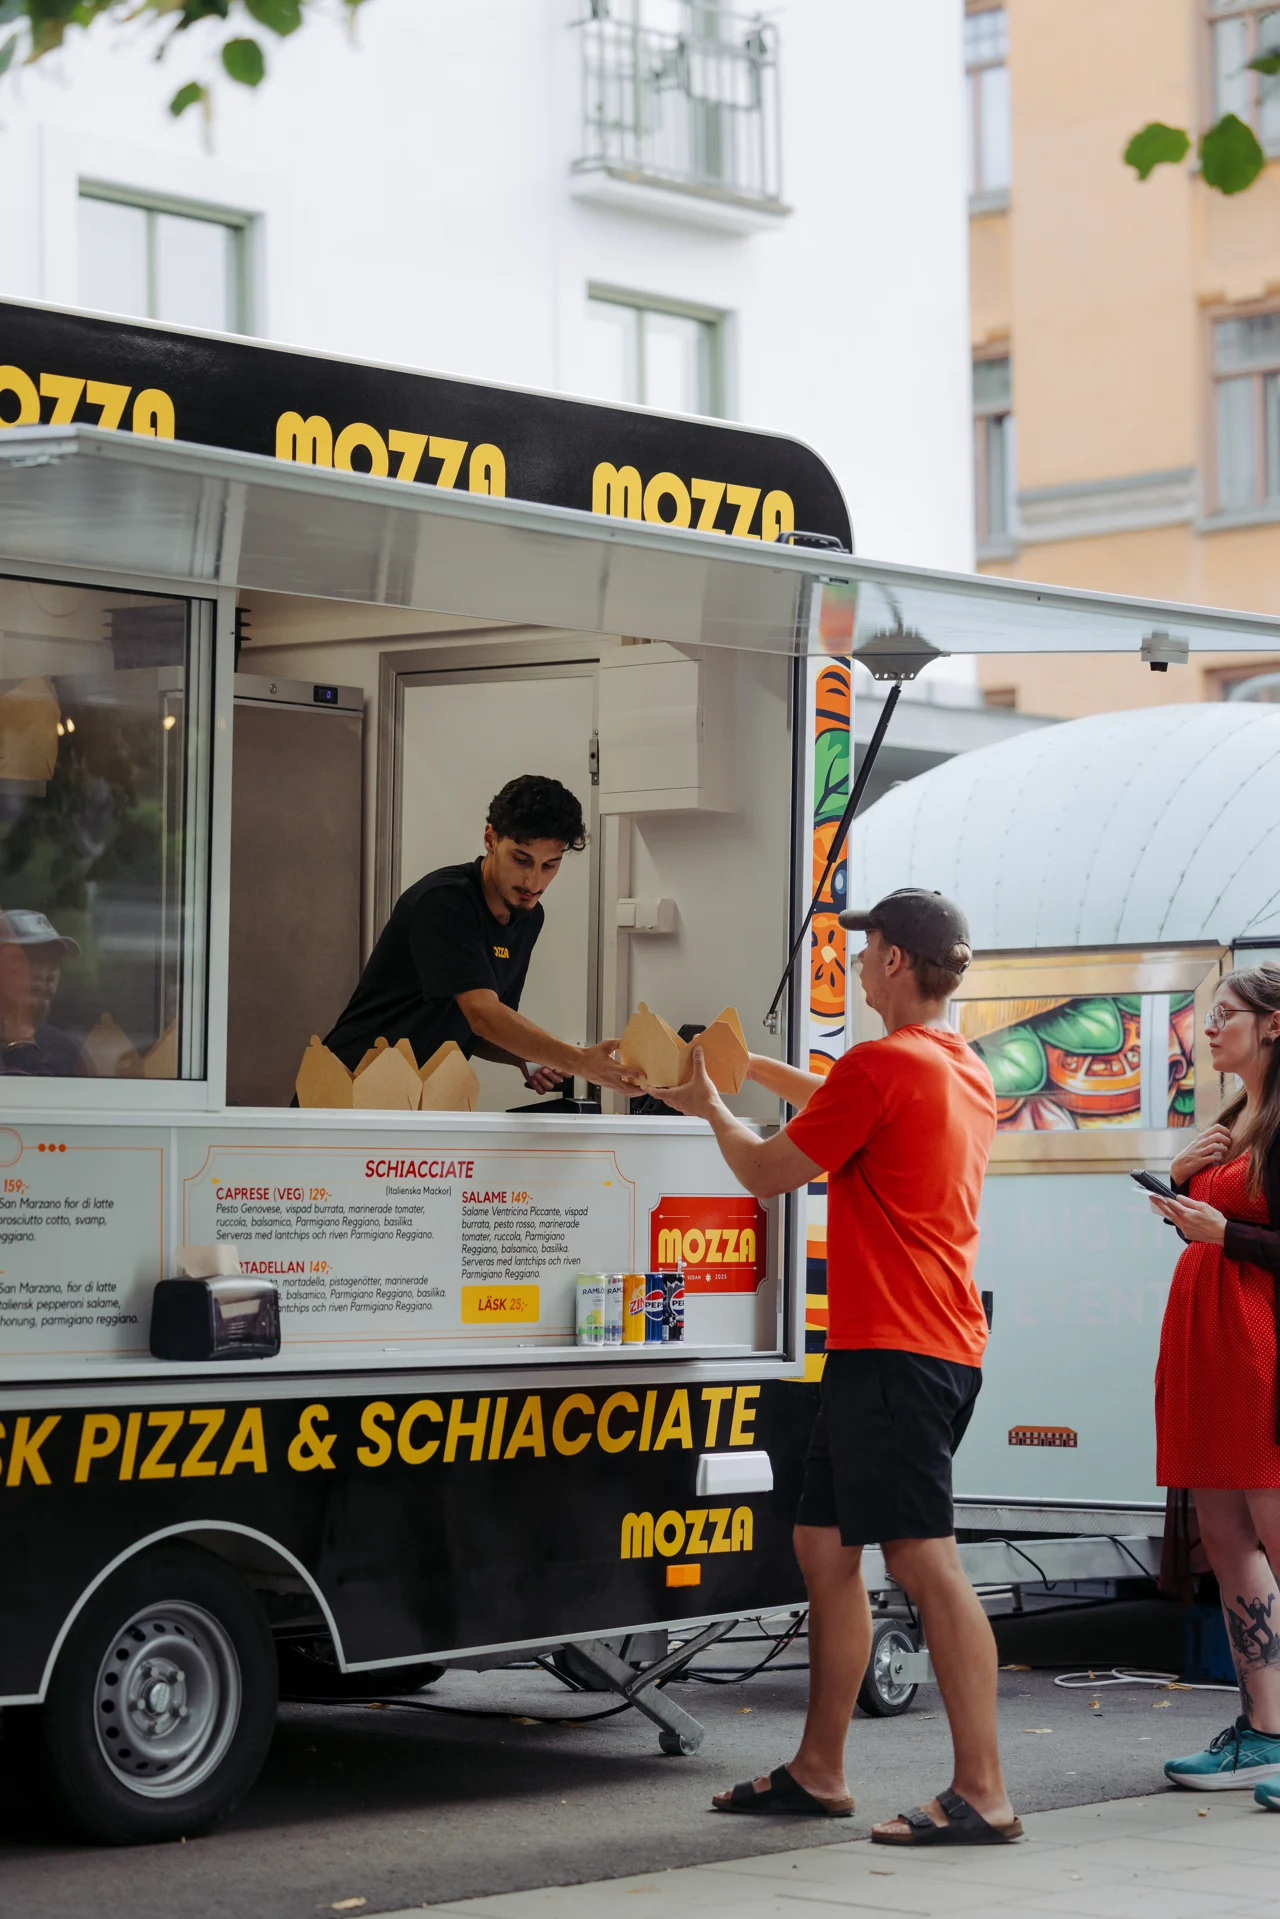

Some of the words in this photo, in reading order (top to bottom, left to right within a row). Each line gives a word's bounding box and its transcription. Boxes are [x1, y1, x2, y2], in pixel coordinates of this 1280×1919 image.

[0, 365, 175, 440] OZZA
[275, 411, 506, 498] MOZZA
[592, 462, 795, 546] MOZZA
[493, 946, 510, 959] OZZA
[365, 1160, 475, 1178] SCHIACCIATE
[216, 1187, 270, 1200] CAPRESE
[273, 1187, 305, 1202] (VEG)
[385, 1186, 422, 1196] (Italienska
[423, 1186, 452, 1196] Mackor)
[462, 1191, 507, 1203] SALAME
[19, 1198, 61, 1209] Marzano
[64, 1198, 79, 1209] fior
[82, 1198, 92, 1209] di
[94, 1198, 114, 1209] latte
[216, 1203, 239, 1213] Pesto
[240, 1203, 283, 1214] Genovese,
[285, 1203, 313, 1215] vispad
[314, 1203, 345, 1214] burrata,
[348, 1204, 393, 1214] marinerade
[395, 1205, 426, 1215] tomater,
[462, 1207, 490, 1217] Salame
[492, 1207, 529, 1217] Ventricina
[530, 1206, 562, 1218] Piccante,
[564, 1206, 589, 1218] vispad
[46, 1215, 72, 1226] cotto,
[75, 1216, 108, 1227] svamp,
[216, 1217, 248, 1228] ruccola,
[251, 1217, 293, 1228] balsamico,
[295, 1217, 340, 1229] Parmigiano
[341, 1217, 381, 1229] Reggiano,
[384, 1216, 414, 1227] basilika.
[462, 1219, 492, 1230] burrata,
[494, 1220, 515, 1231] pesto
[516, 1221, 537, 1230] rosso,
[539, 1218, 580, 1229] marinerade
[0, 1230, 37, 1244] ggiano.
[216, 1230, 252, 1240] Serveras
[255, 1229, 273, 1240] med
[275, 1229, 310, 1241] lantchips
[311, 1229, 327, 1240] och
[328, 1229, 349, 1239] riven
[350, 1229, 395, 1241] Parmigiano
[395, 1229, 434, 1241] Reggiano.
[462, 1232, 492, 1243] tomater,
[494, 1231, 523, 1242] ruccola,
[525, 1231, 566, 1243] Parmigiano
[462, 1244, 499, 1256] Reggiano,
[501, 1243, 539, 1255] balsamico,
[541, 1243, 570, 1254] basilika.
[658, 1228, 756, 1263] MOZZA
[239, 1261, 305, 1274] TADELLAN
[462, 1257, 495, 1267] Serveras
[496, 1256, 513, 1267] med
[514, 1256, 547, 1268] lantchips
[548, 1256, 562, 1266] och
[563, 1255, 581, 1266] riven
[462, 1269, 503, 1281] Parmigiano
[504, 1269, 541, 1281] Reggiano.
[19, 1282, 63, 1294] Marzano,
[66, 1282, 82, 1293] fior
[84, 1282, 94, 1292] di
[97, 1281, 117, 1292] latte
[282, 1277, 326, 1288] mortadella,
[329, 1276, 382, 1289] pistagenötter,
[385, 1275, 429, 1286] marinerade
[286, 1289, 327, 1300] balsamico,
[330, 1288, 374, 1301] Parmigiano
[375, 1288, 414, 1300] Reggiano,
[417, 1287, 447, 1298] basilika.
[607, 1287, 623, 1295] RAM
[0, 1298, 33, 1310] aliensk
[36, 1298, 84, 1312] pepperoni
[86, 1297, 121, 1309] salame,
[279, 1302, 310, 1314] antchips
[312, 1302, 327, 1312] och
[328, 1302, 349, 1312] riven
[350, 1302, 394, 1313] Parmigiano
[395, 1300, 434, 1313] Reggiano.
[478, 1297, 507, 1311] LÄSK
[41, 1314, 93, 1328] parmigiano
[96, 1313, 139, 1326] reggiano.
[0, 1415, 62, 1487] K
[74, 1407, 268, 1484] PIZZA
[287, 1404, 337, 1471] &
[356, 1385, 761, 1468] SCHIACCIATE
[620, 1506, 753, 1560] MOZZA
